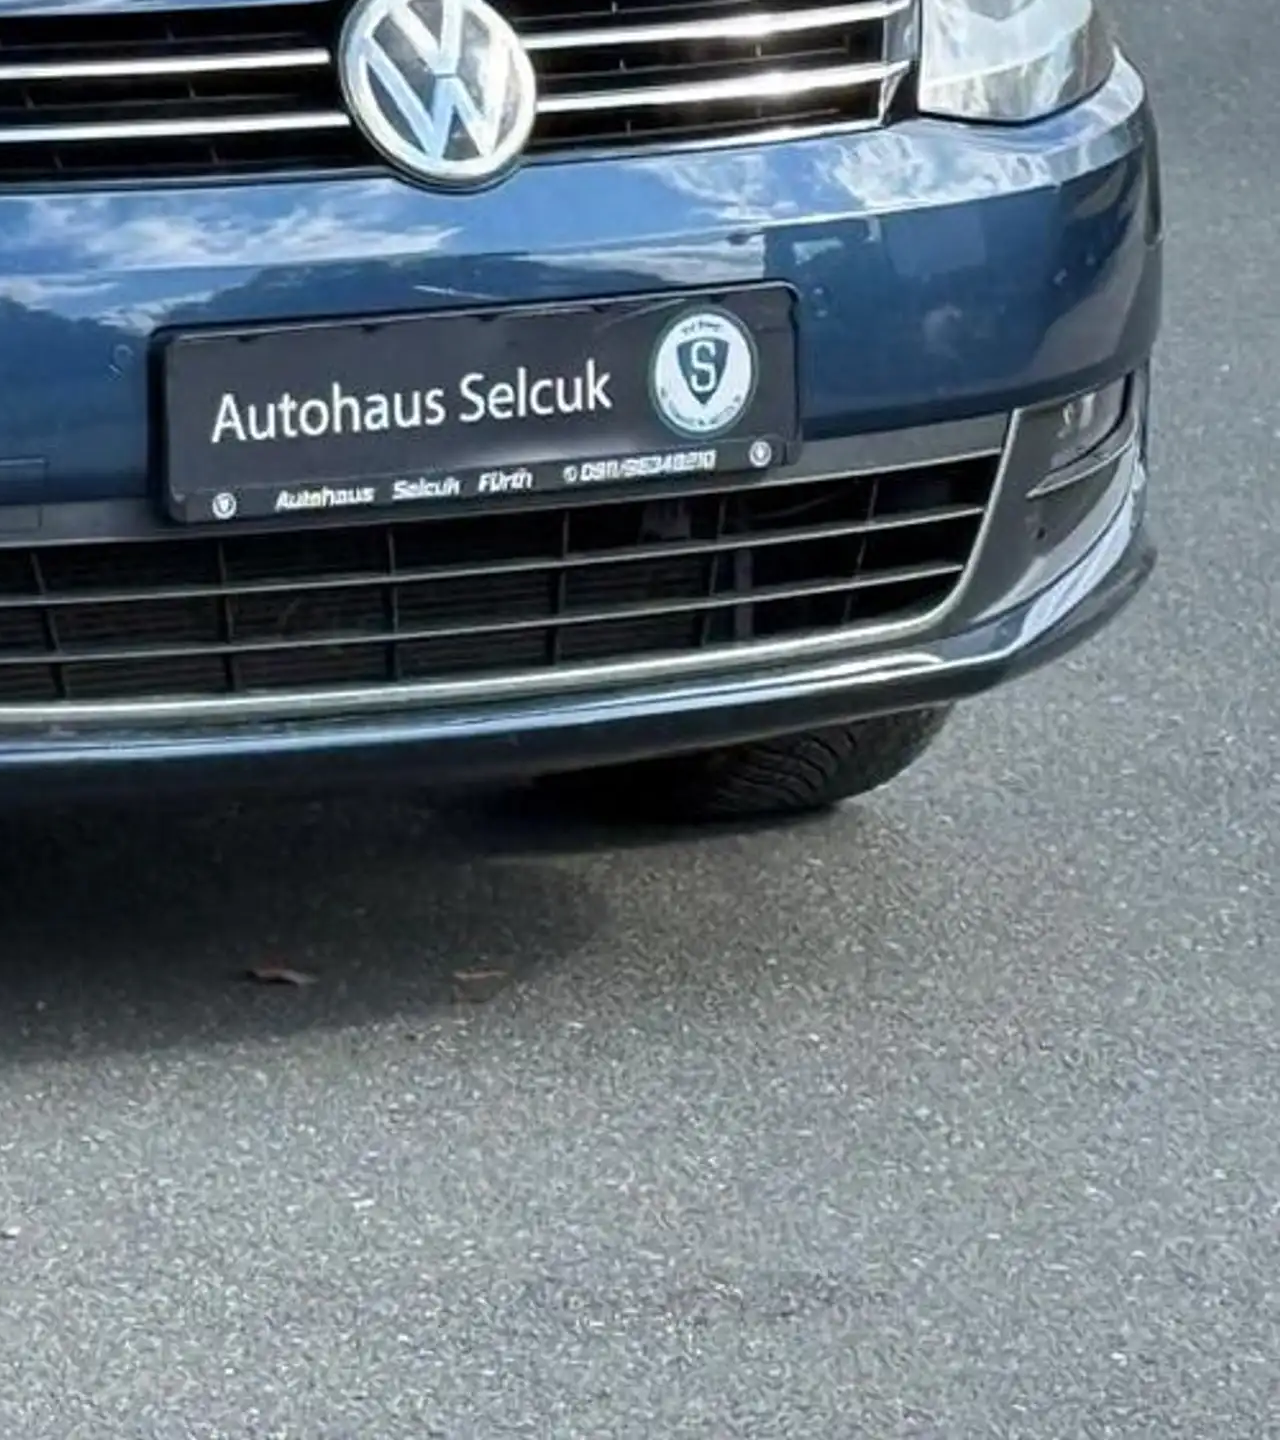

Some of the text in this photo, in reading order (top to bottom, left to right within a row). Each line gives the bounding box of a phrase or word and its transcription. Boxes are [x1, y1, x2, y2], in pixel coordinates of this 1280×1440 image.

[210, 357, 613, 444] Autohaus Selcuk
[274, 485, 377, 512] Autohaus
[478, 467, 534, 493] Fürth
